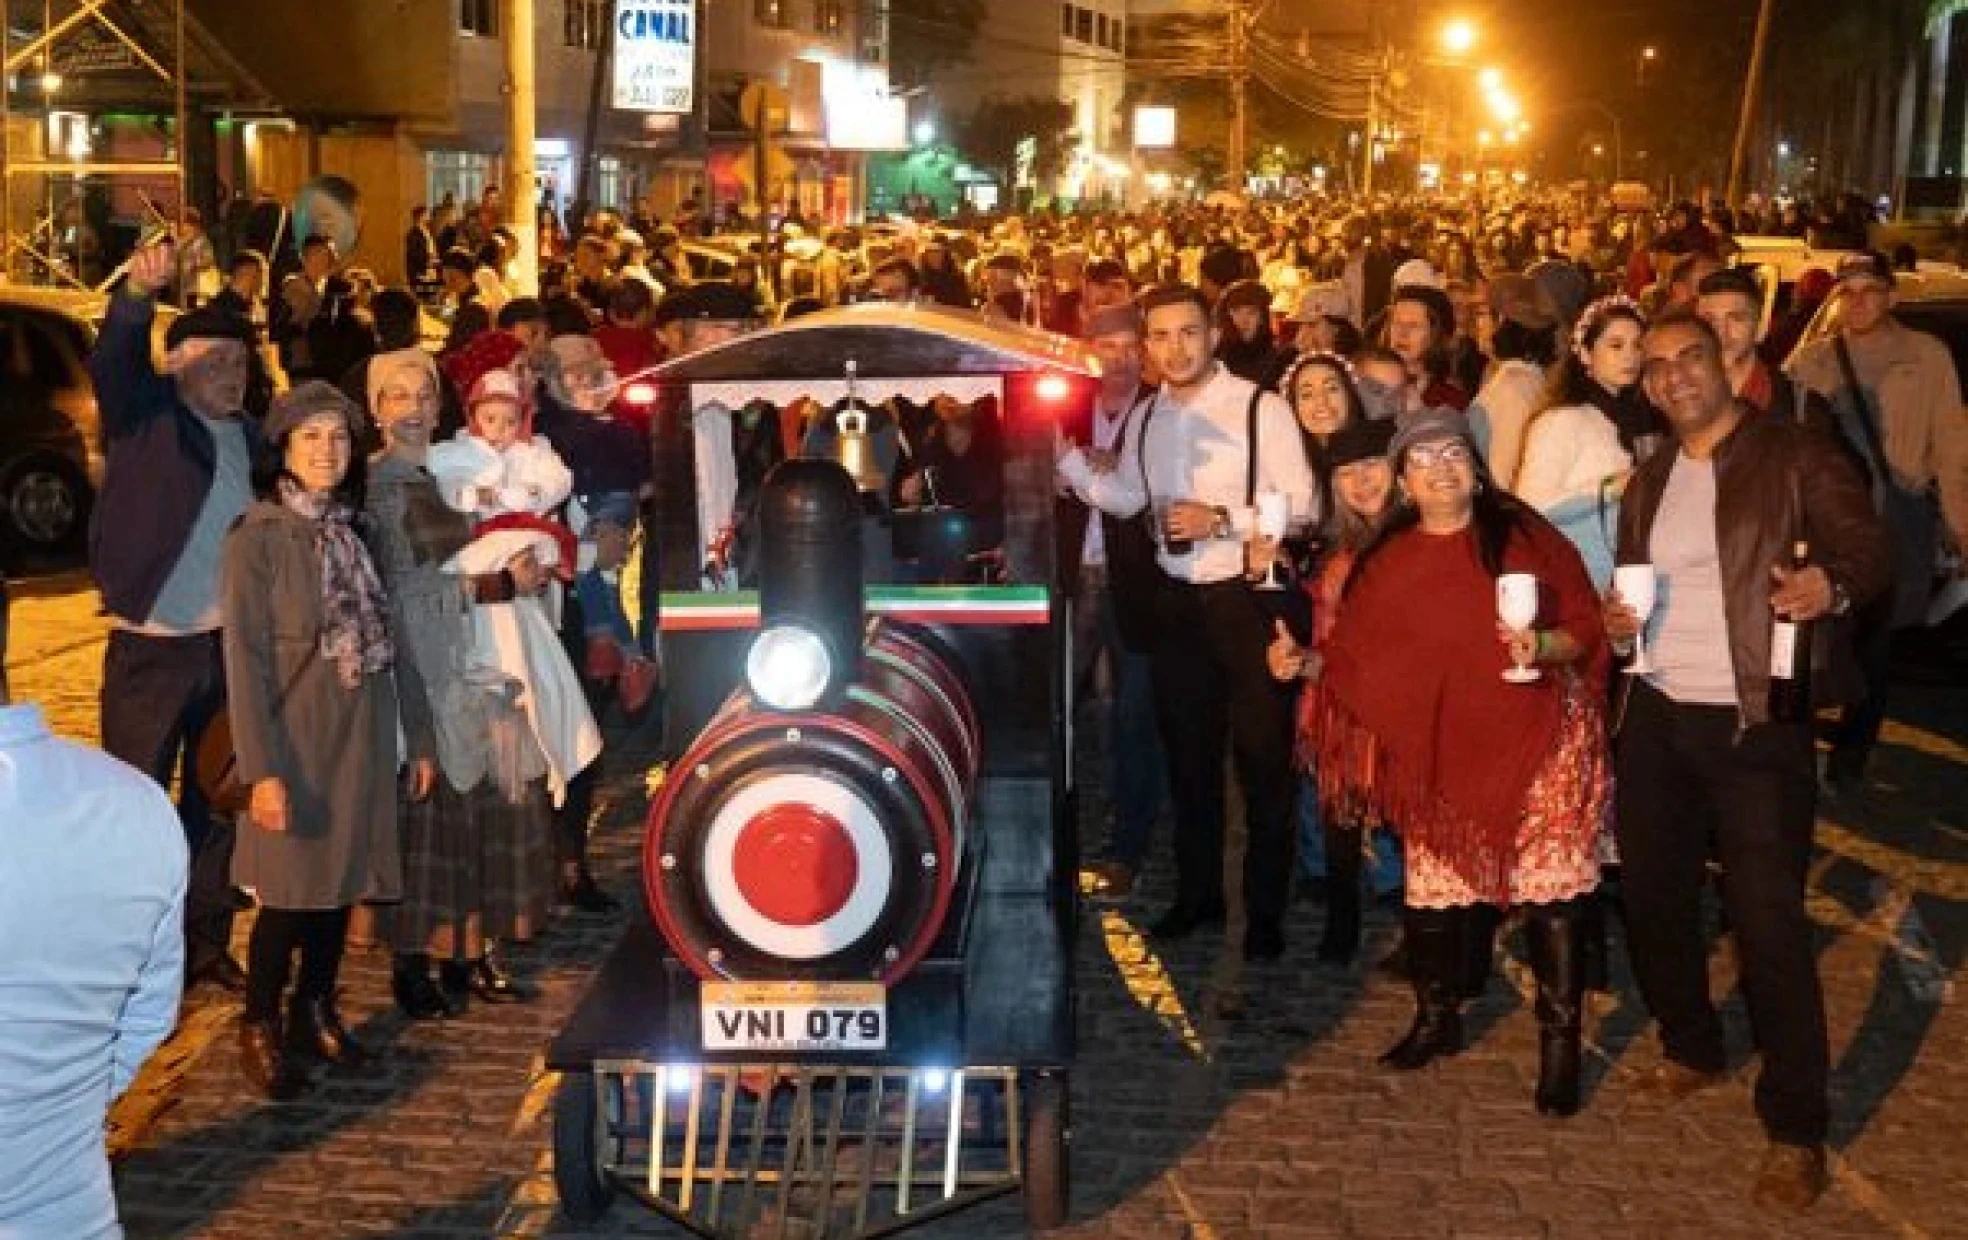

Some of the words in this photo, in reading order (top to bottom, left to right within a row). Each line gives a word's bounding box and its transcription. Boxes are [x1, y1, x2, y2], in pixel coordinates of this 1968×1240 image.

[618, 9, 690, 44] CANAL
[715, 1009, 785, 1040] VNI
[806, 1009, 880, 1040] 079
